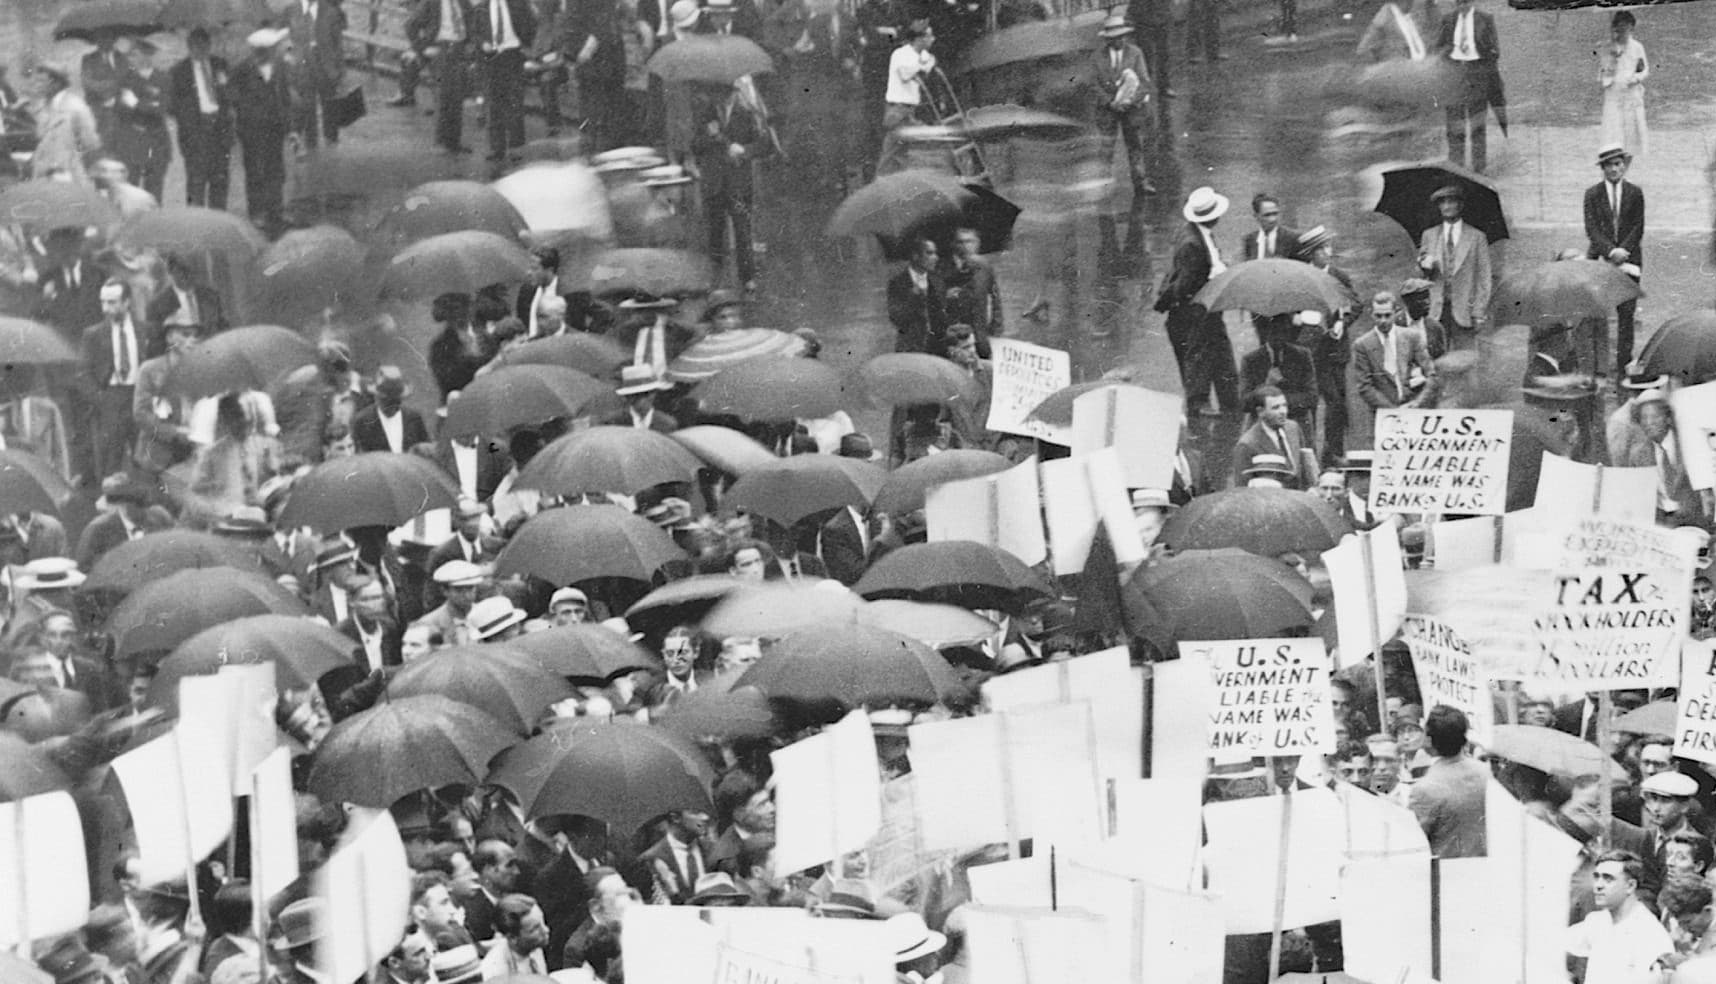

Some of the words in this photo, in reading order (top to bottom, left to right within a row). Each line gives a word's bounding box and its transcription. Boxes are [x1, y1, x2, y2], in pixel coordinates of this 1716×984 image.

[1002, 346, 1054, 372] UNITED
[1421, 415, 1483, 436] U.S.
[1380, 438, 1505, 451] GOVERNMENT
[1404, 455, 1485, 472] LIABLE
[1402, 474, 1442, 488] NAME
[1451, 474, 1490, 489] WAS
[1376, 492, 1421, 507] BANK
[1554, 573, 1649, 606] TAX
[1405, 617, 1472, 656] CHANGE
[1236, 645, 1301, 668] U.S.
[1214, 667, 1320, 688] VERNMENT
[1446, 656, 1478, 680] LAWS
[1220, 688, 1297, 707] LIABLE
[1274, 706, 1316, 723] WAS
[1209, 731, 1249, 749] ANK
[1274, 727, 1320, 749] U.S.
